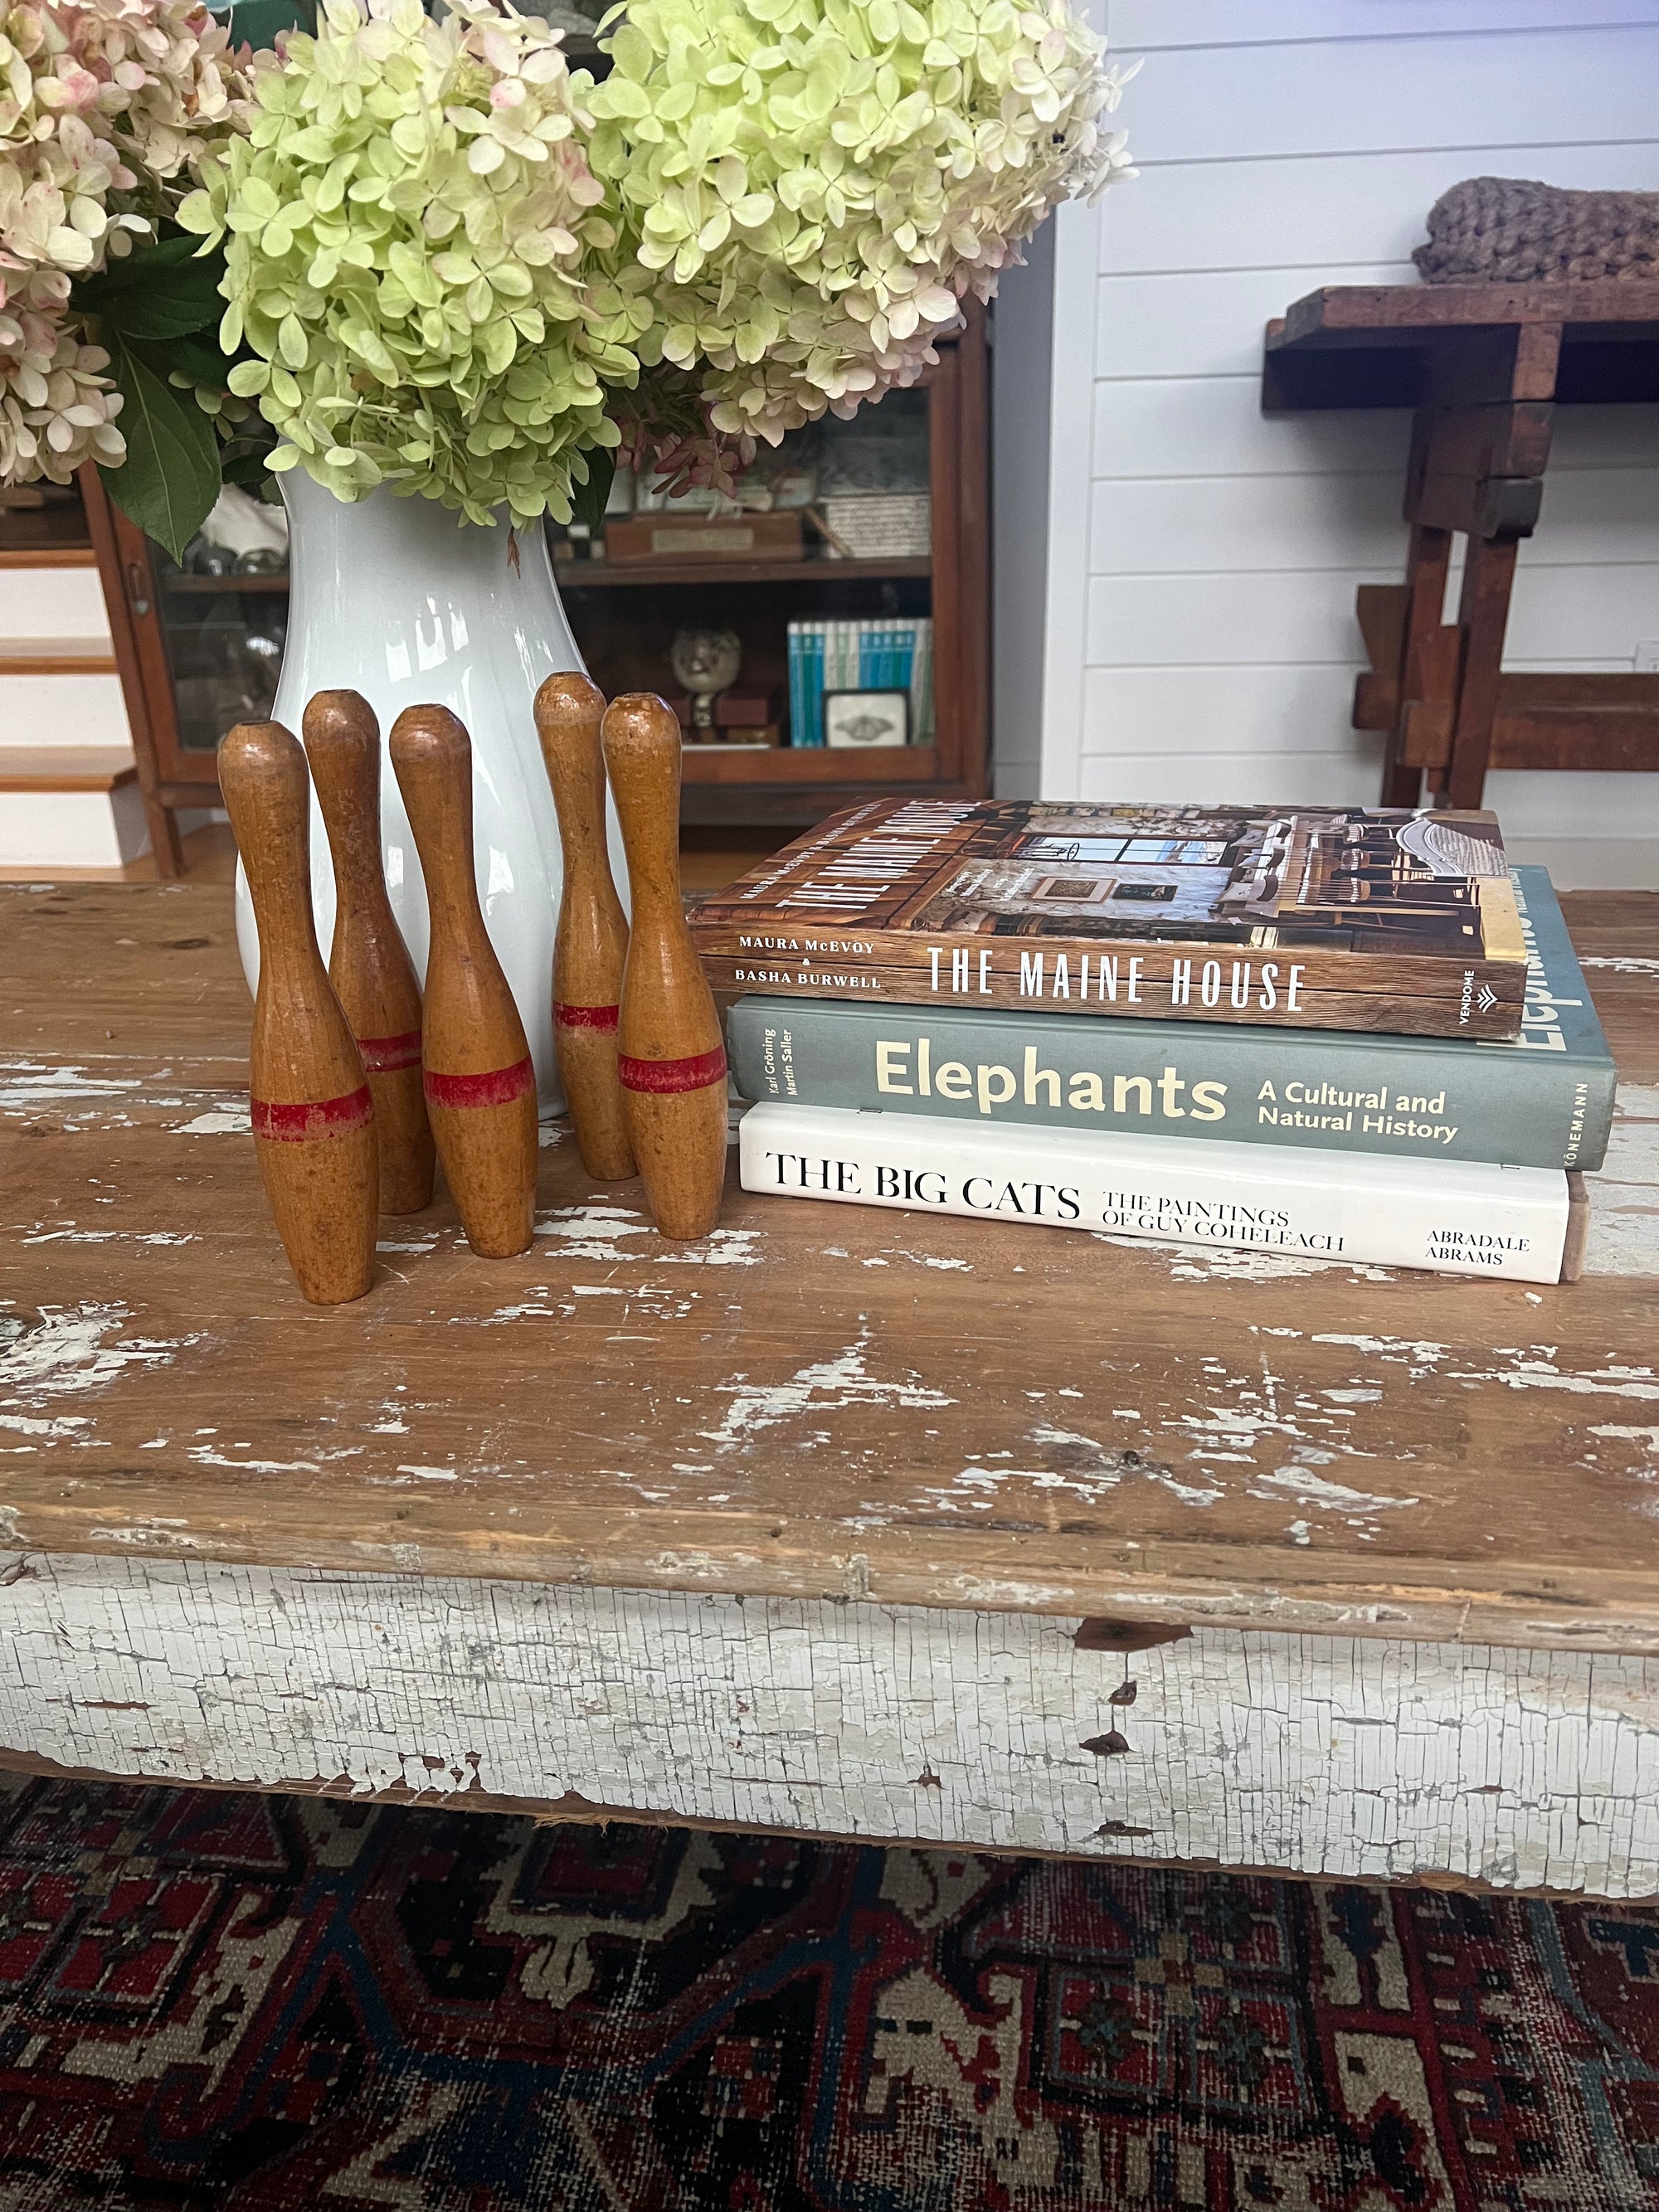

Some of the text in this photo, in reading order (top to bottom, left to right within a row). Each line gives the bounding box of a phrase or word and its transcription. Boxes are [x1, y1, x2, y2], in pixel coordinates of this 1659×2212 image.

[775, 800, 983, 910] THE MAINE HOUSE
[739, 936, 875, 954] MAURA McEVOY
[735, 970, 881, 989] BASHA BURWELL
[927, 946, 1306, 1012] THE MAINE HOUSE
[1459, 970, 1475, 1025] VENDOME
[761, 1028, 780, 1094] Karl Gröning
[780, 1029, 798, 1096] Martin Saller
[875, 1038, 1228, 1122] Elephants
[1257, 1080, 1446, 1115] A Cultural and
[1258, 1106, 1459, 1145] Natural History
[766, 1152, 1081, 1220] THE BIG CATS
[1102, 1191, 1289, 1227] THE PAINTINGS
[1102, 1210, 1344, 1252] OF GUY COHELEACH
[1427, 1230, 1530, 1252] ABRADALE
[1425, 1247, 1503, 1266] ABRAMS
